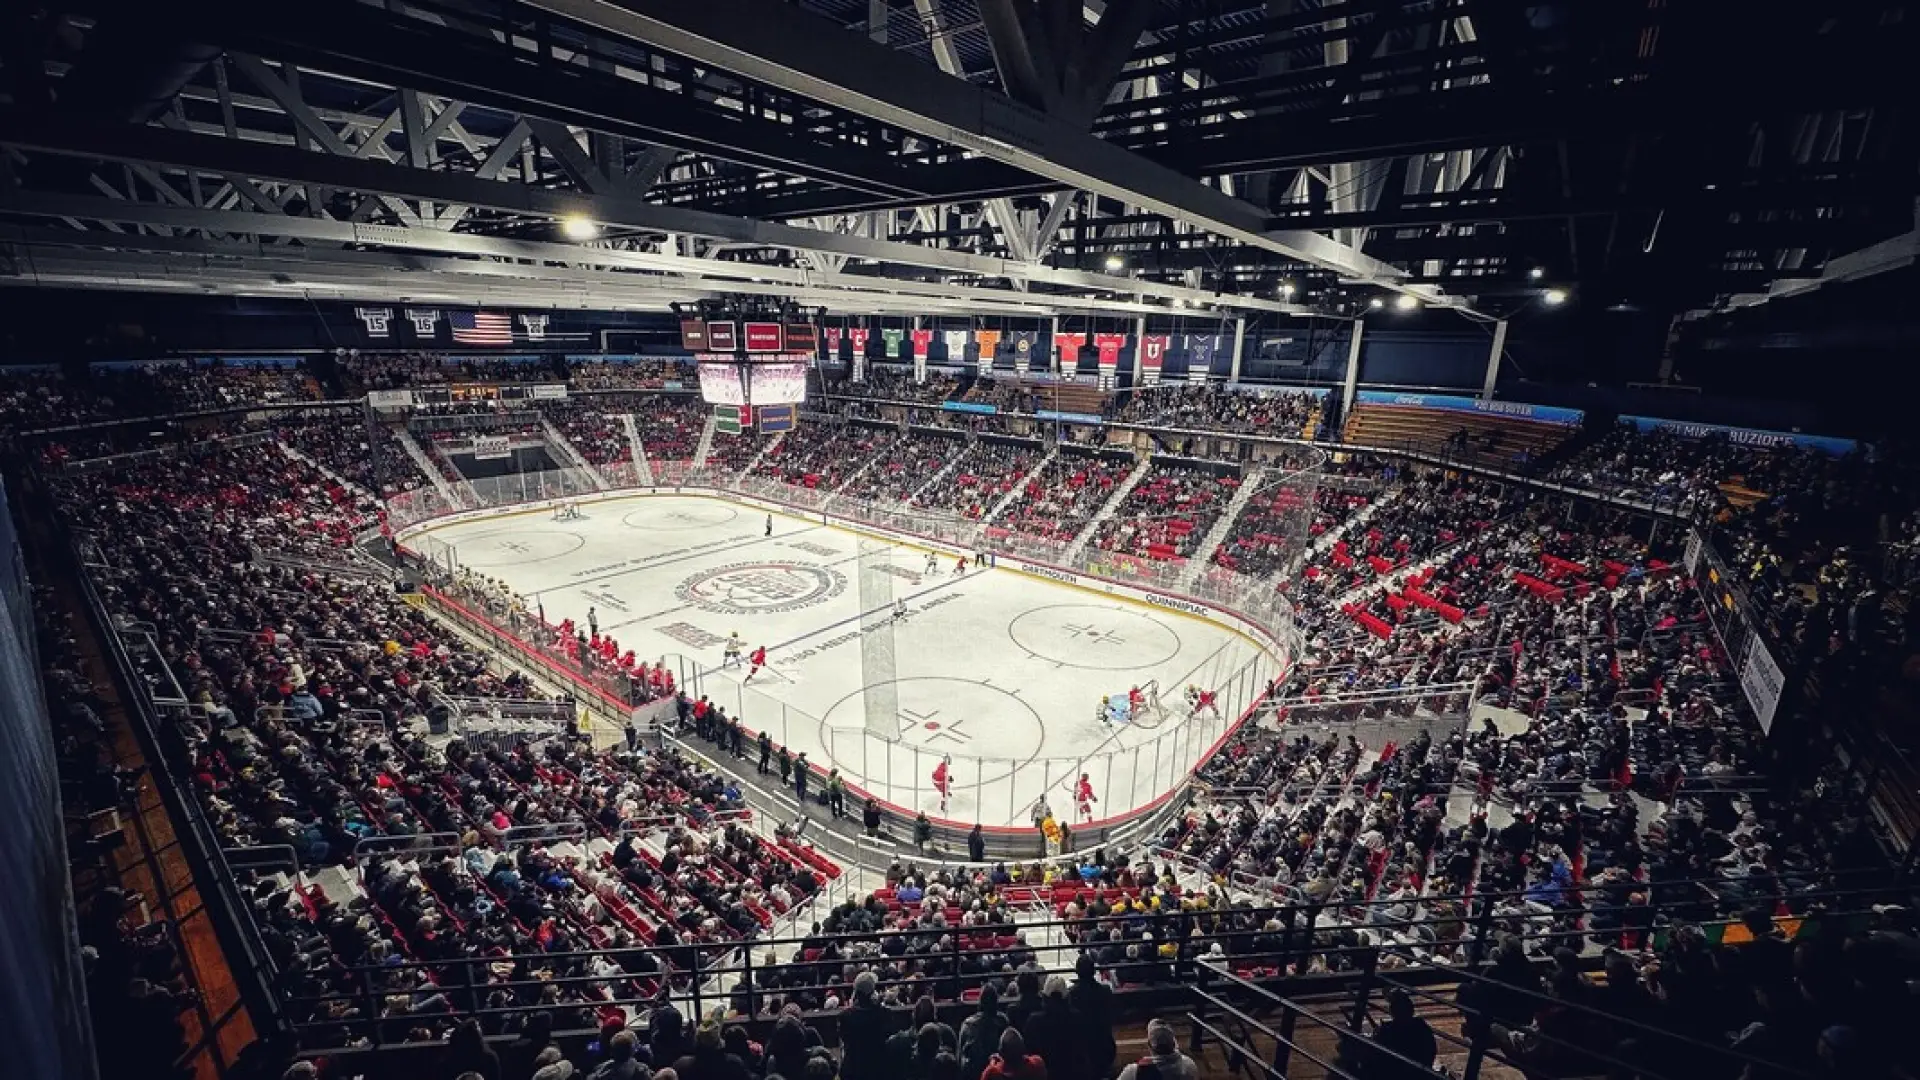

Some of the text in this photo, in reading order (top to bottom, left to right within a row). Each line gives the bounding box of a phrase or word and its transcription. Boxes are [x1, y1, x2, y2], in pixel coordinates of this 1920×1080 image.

[369, 317, 385, 330] 15
[416, 318, 430, 331] 16
[1021, 564, 1077, 584] DARTMOUTH
[1145, 593, 1209, 617] QUINNIPIAC
